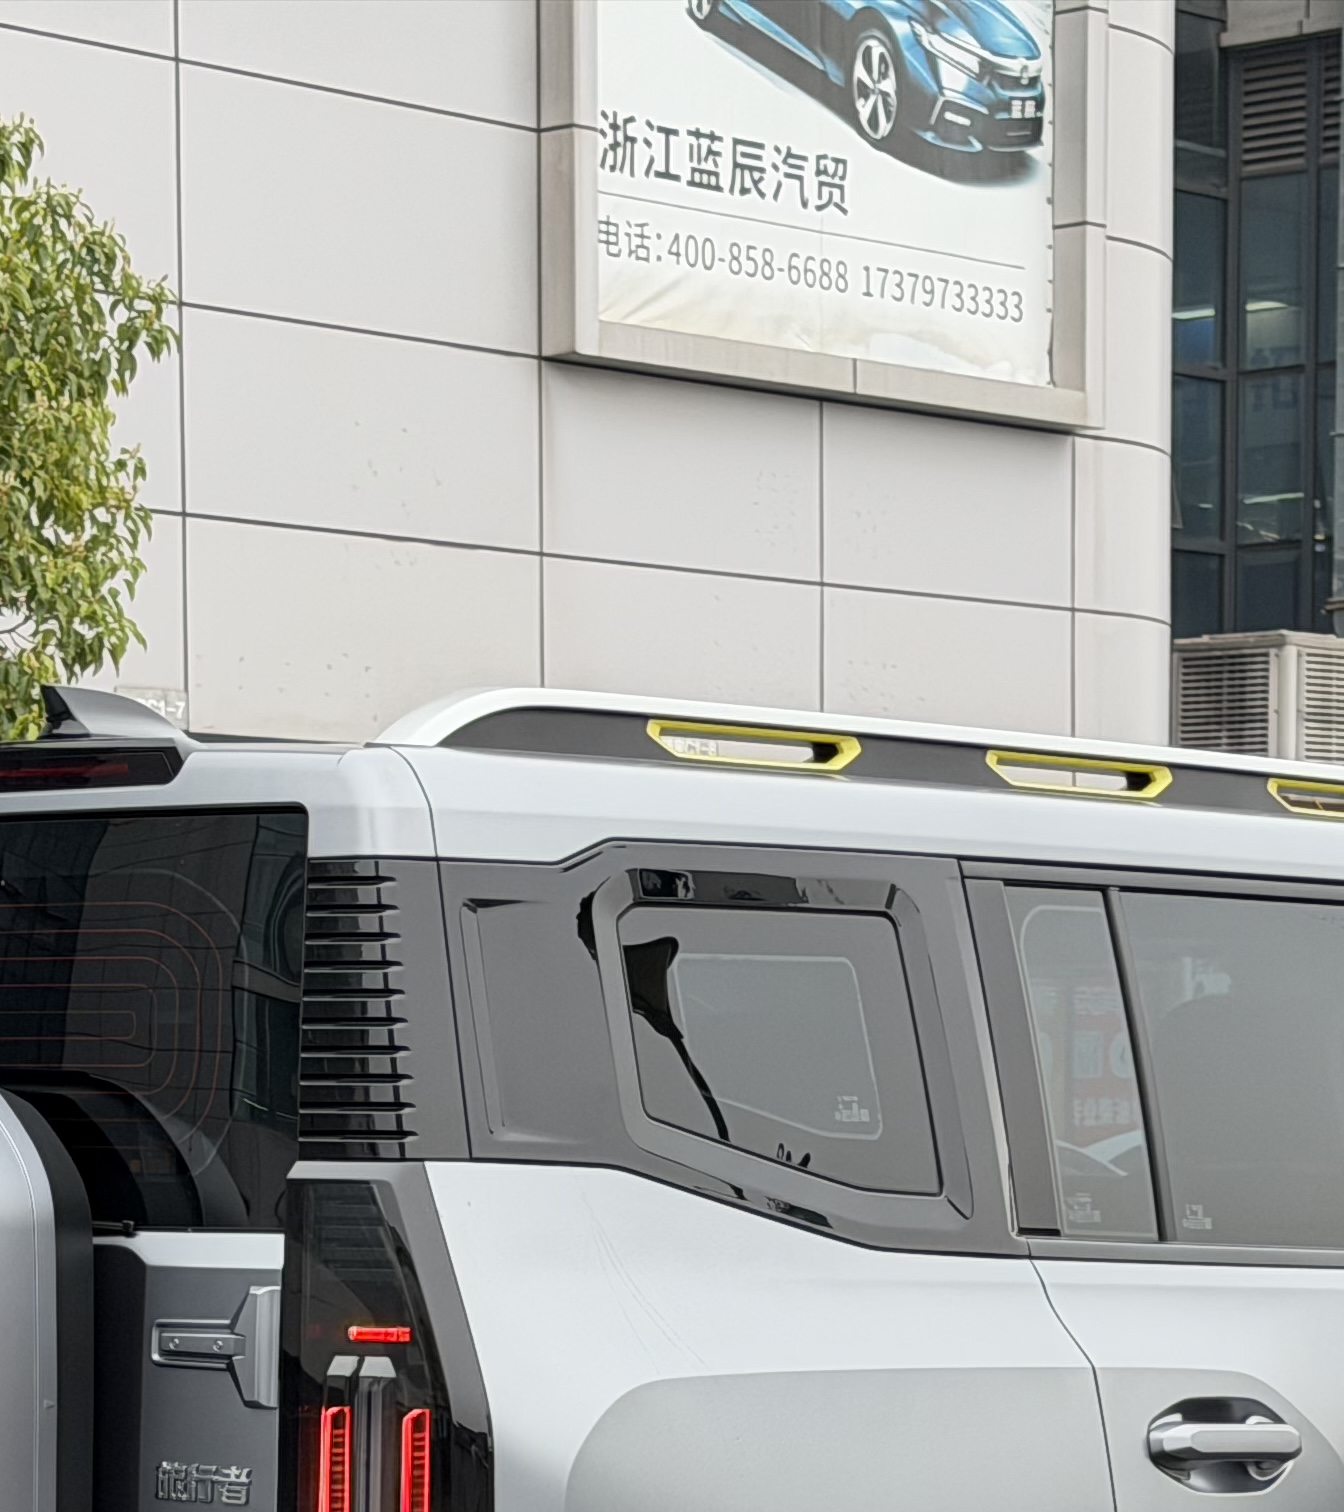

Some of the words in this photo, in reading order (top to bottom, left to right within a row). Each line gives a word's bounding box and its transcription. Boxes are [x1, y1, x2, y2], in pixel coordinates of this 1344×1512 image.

[599, 109, 849, 216] 浙江蓝辰汽贸
[862, 265, 1024, 323] 17379733333
